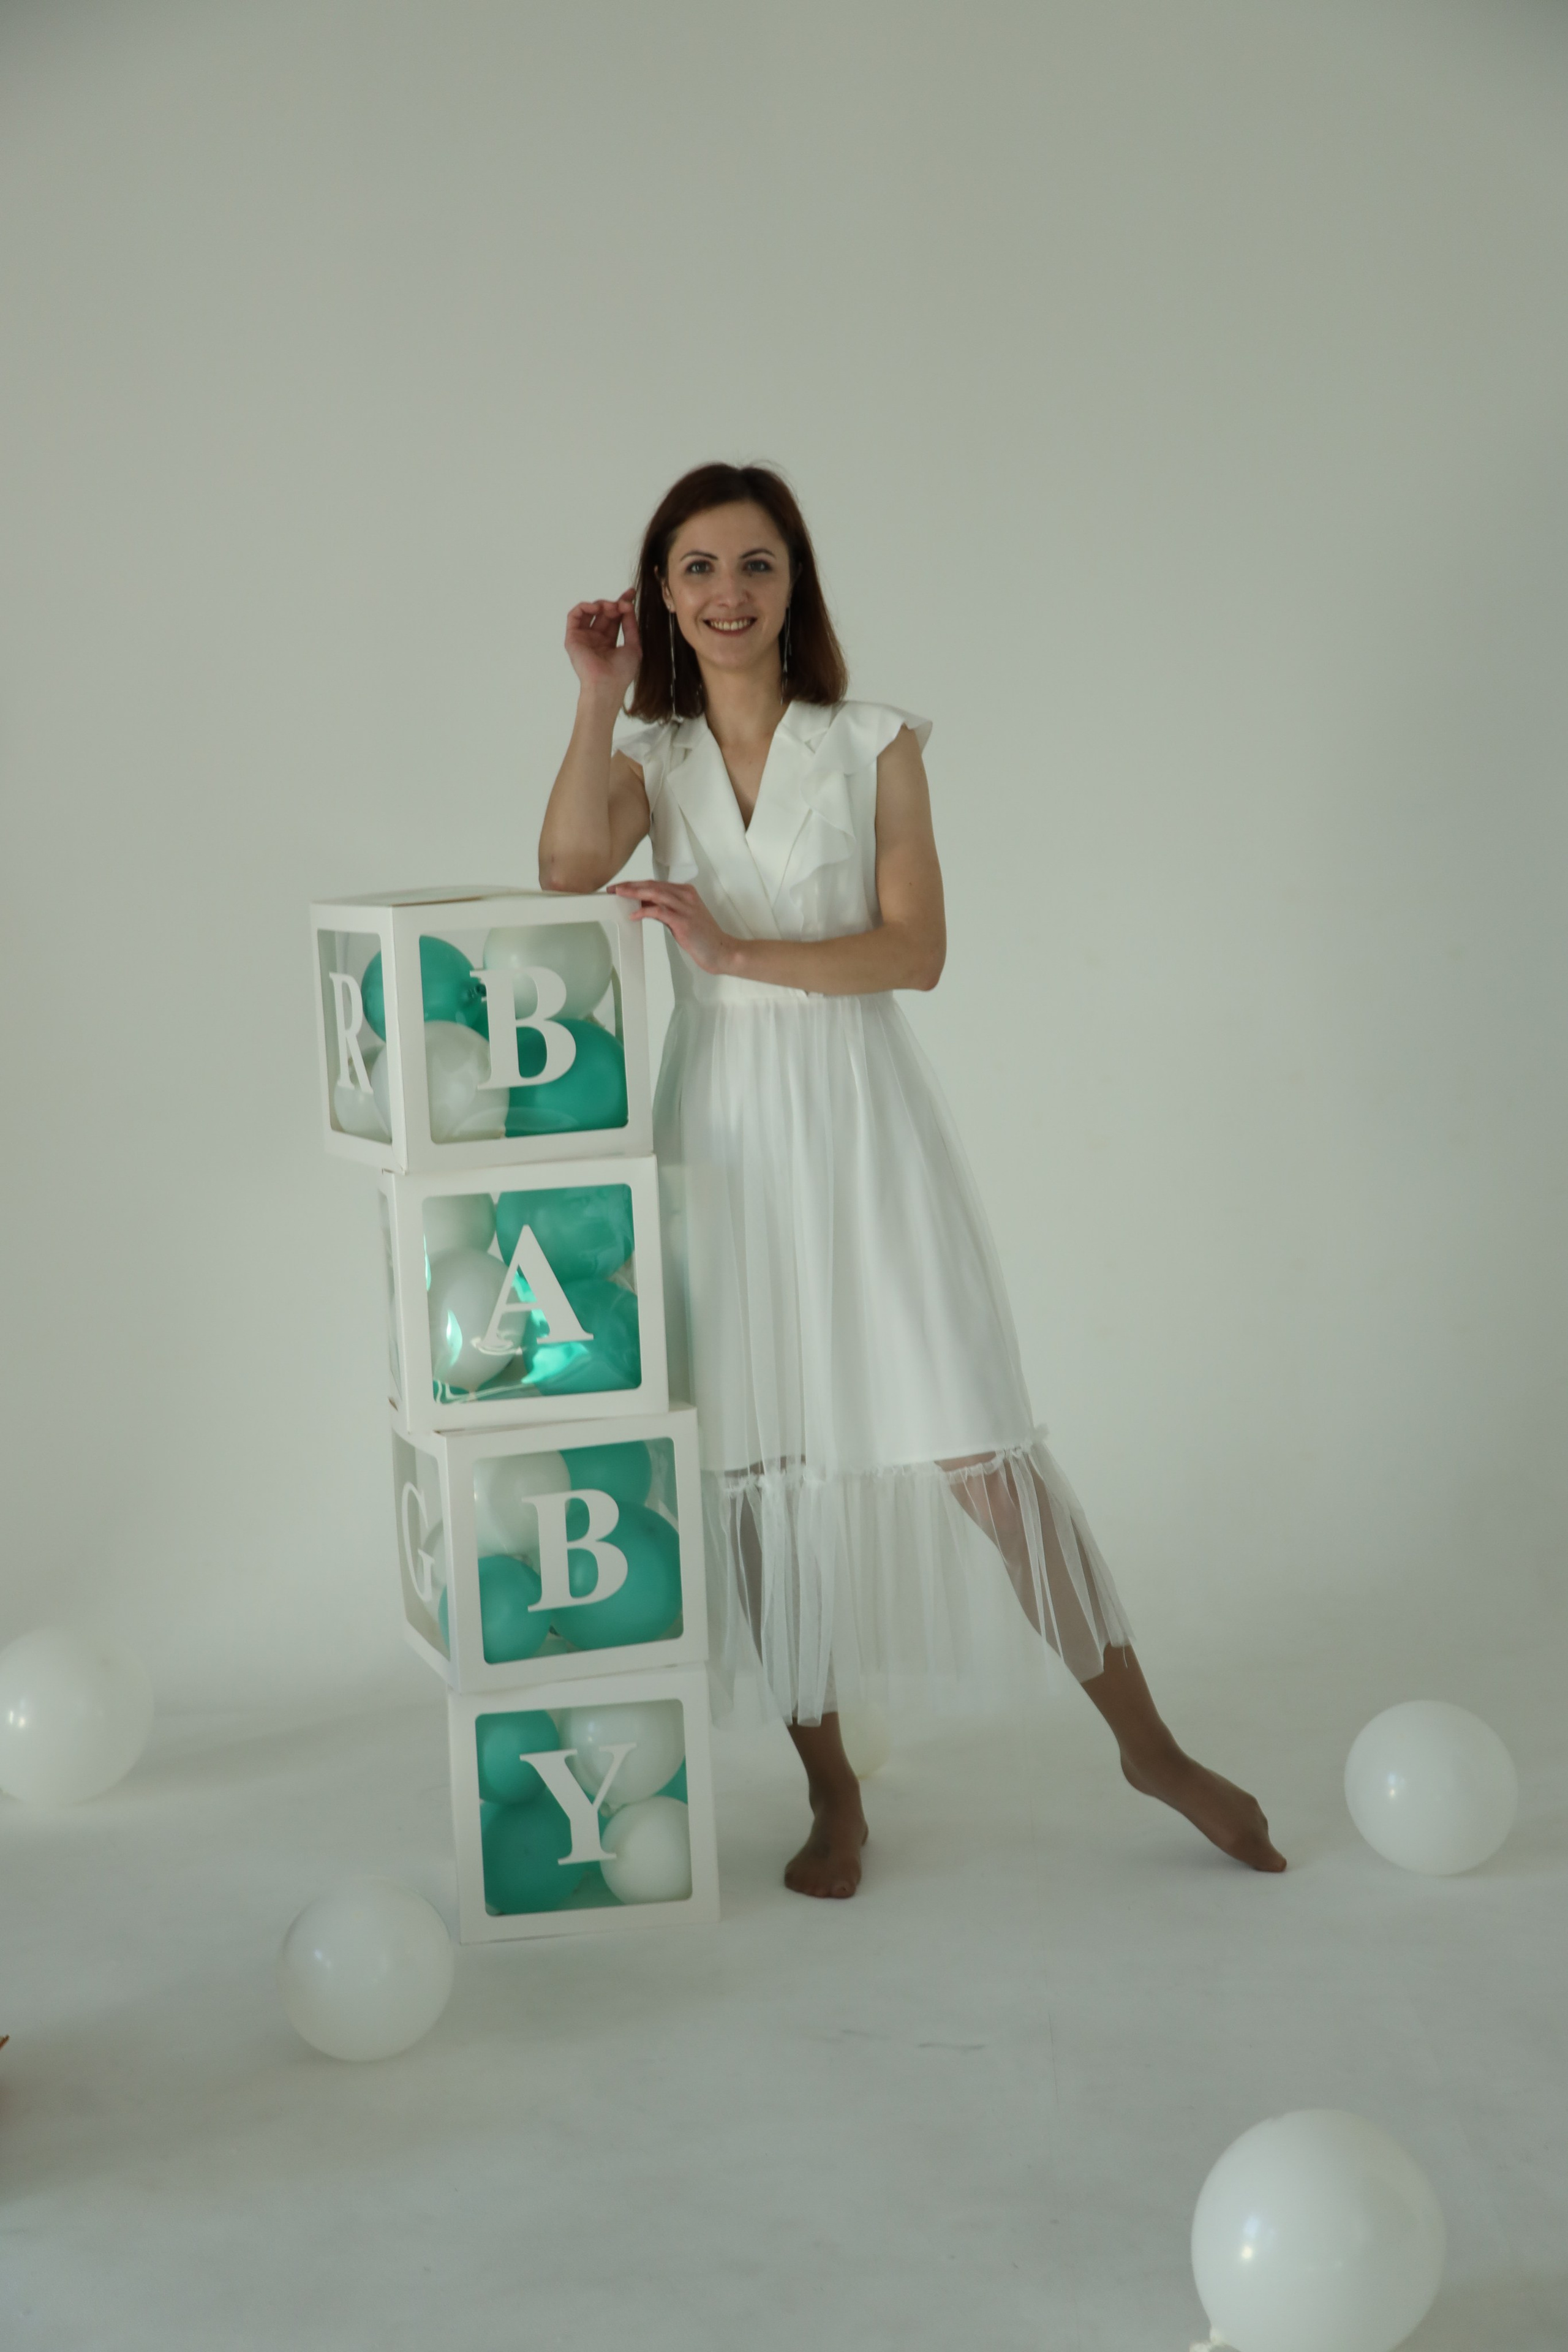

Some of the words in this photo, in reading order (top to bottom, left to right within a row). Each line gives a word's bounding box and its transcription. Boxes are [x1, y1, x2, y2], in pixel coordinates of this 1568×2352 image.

[470, 967, 576, 1090] B
[521, 1488, 628, 1612] B
[519, 1742, 637, 1866] Y
